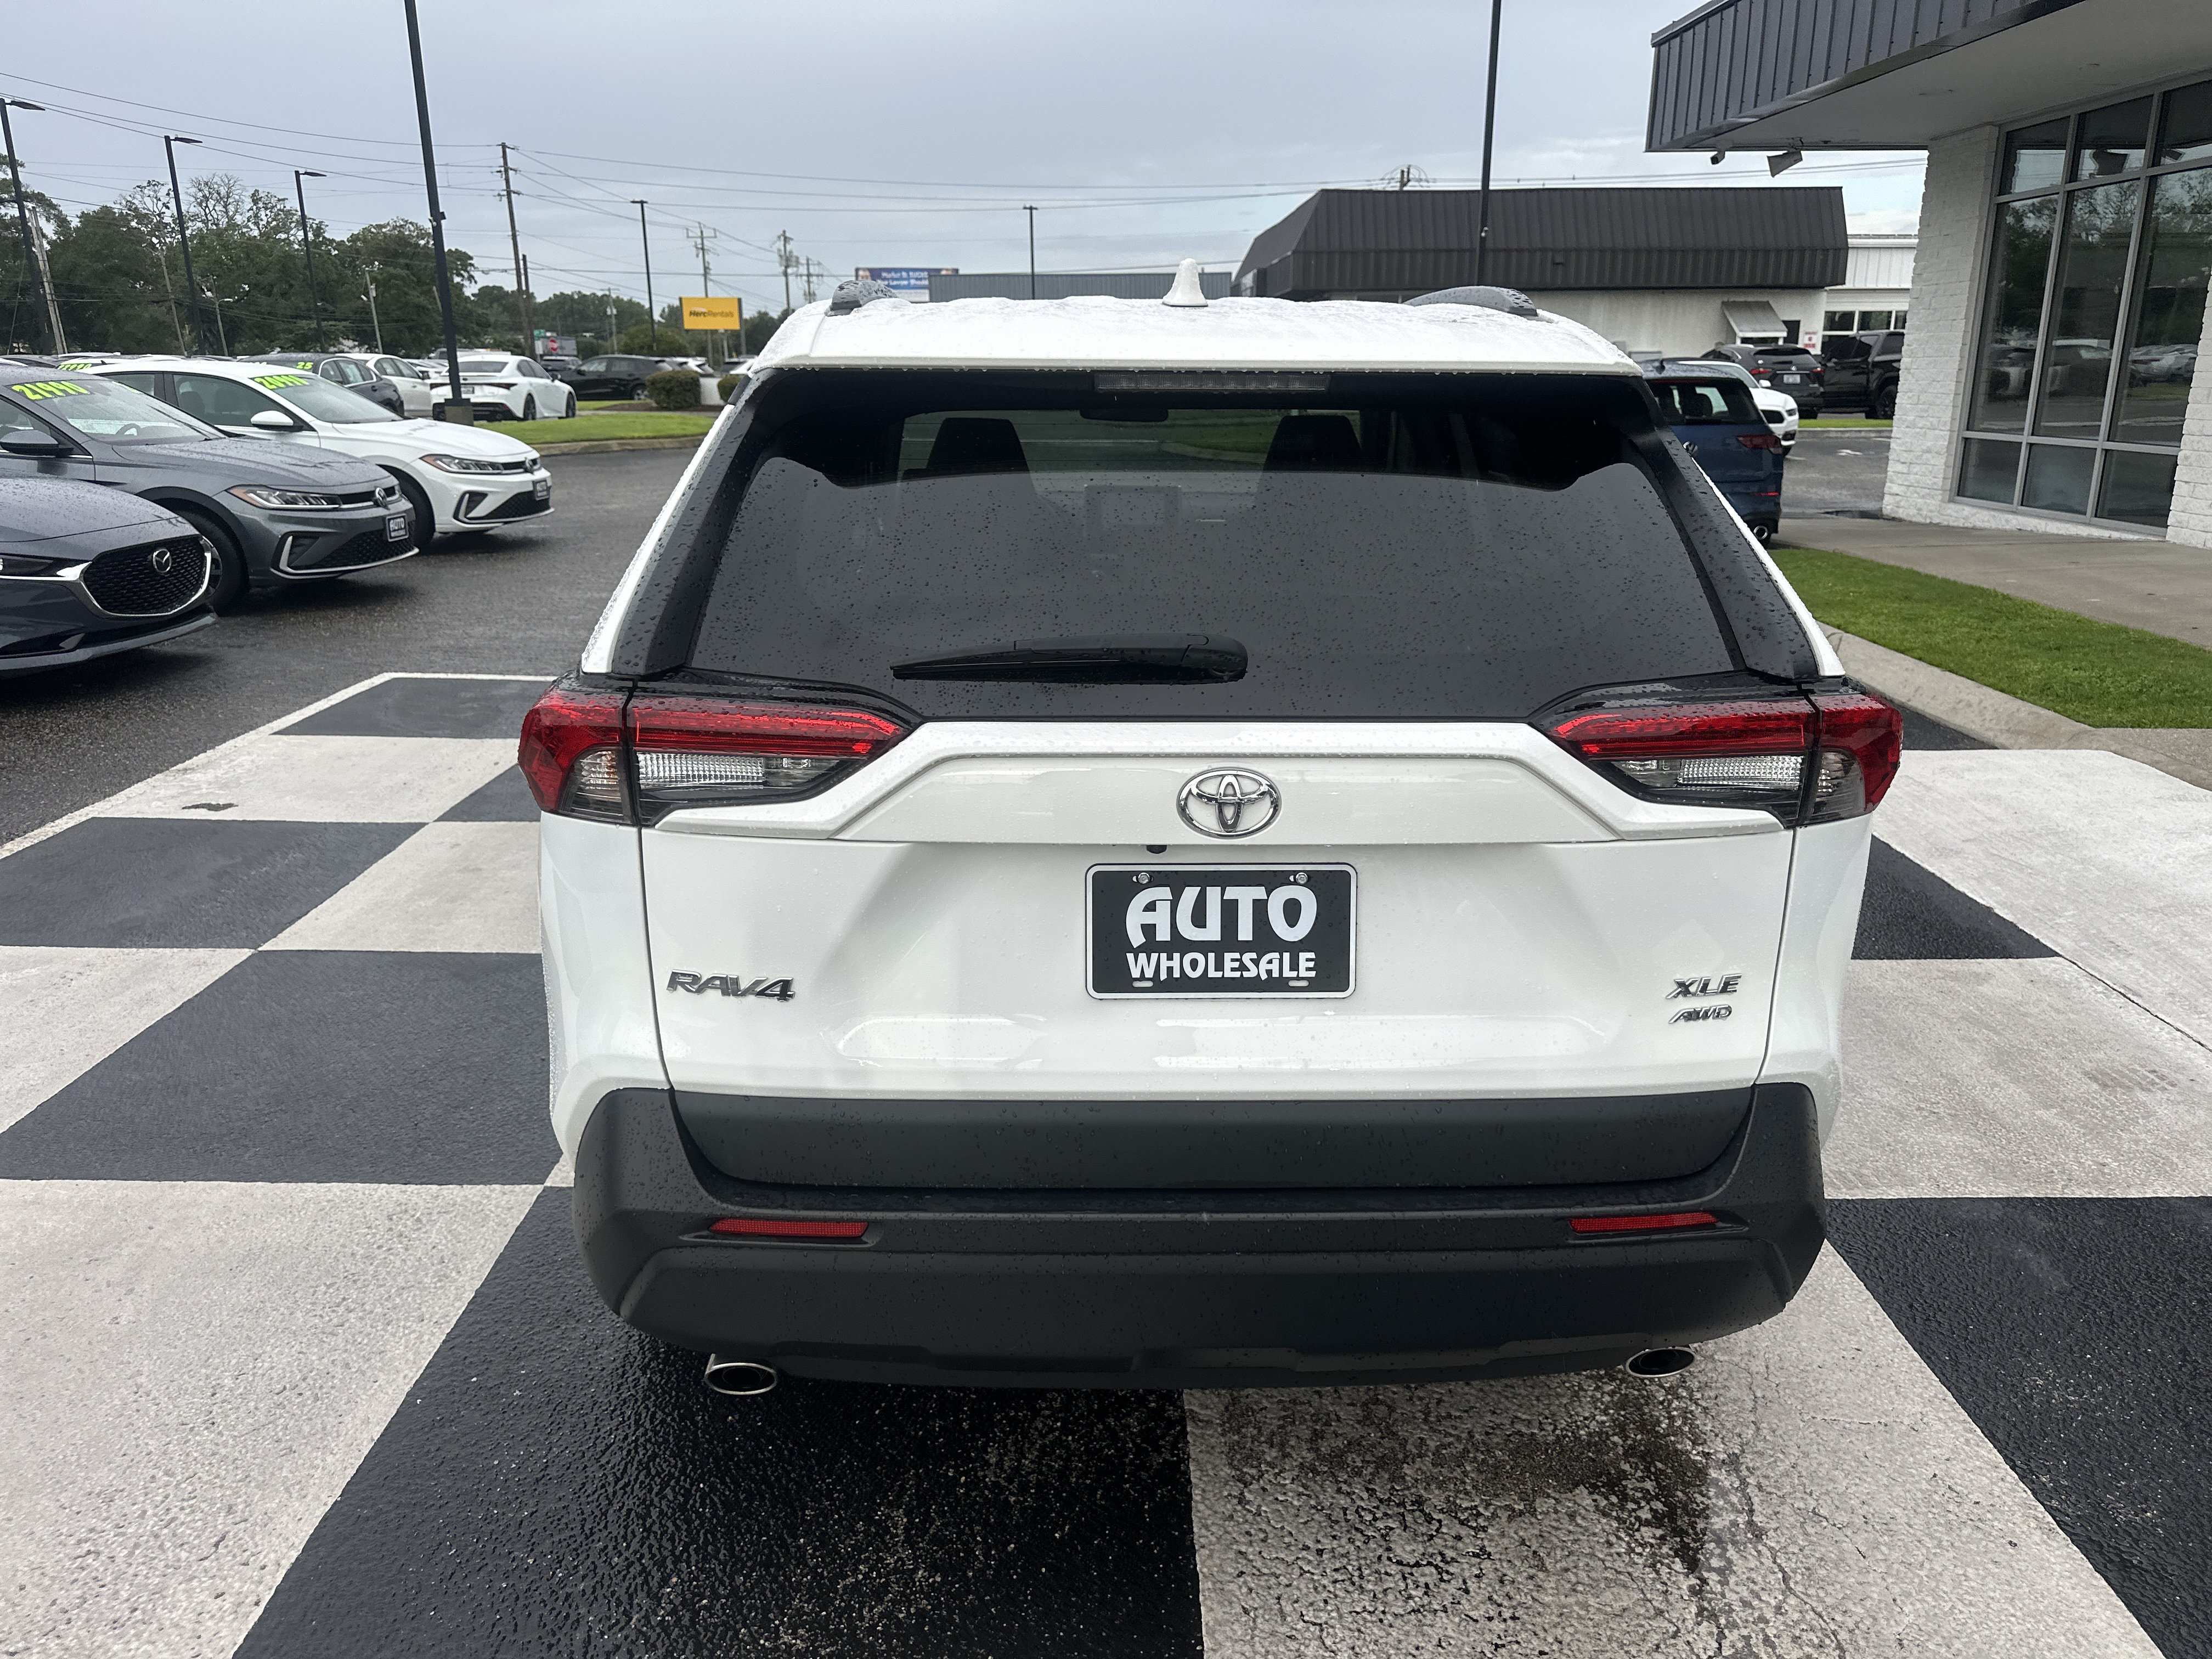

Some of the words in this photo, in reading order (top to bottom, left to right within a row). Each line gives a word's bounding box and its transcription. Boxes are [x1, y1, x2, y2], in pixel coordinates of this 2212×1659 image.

[12, 381, 91, 400] 21990
[1126, 885, 1317, 949] AUTO
[1126, 952, 1316, 981] WHOLESALE
[666, 969, 795, 1002] RAV4
[1665, 973, 1742, 999] XLE
[1668, 1004, 1732, 1024] AWD
